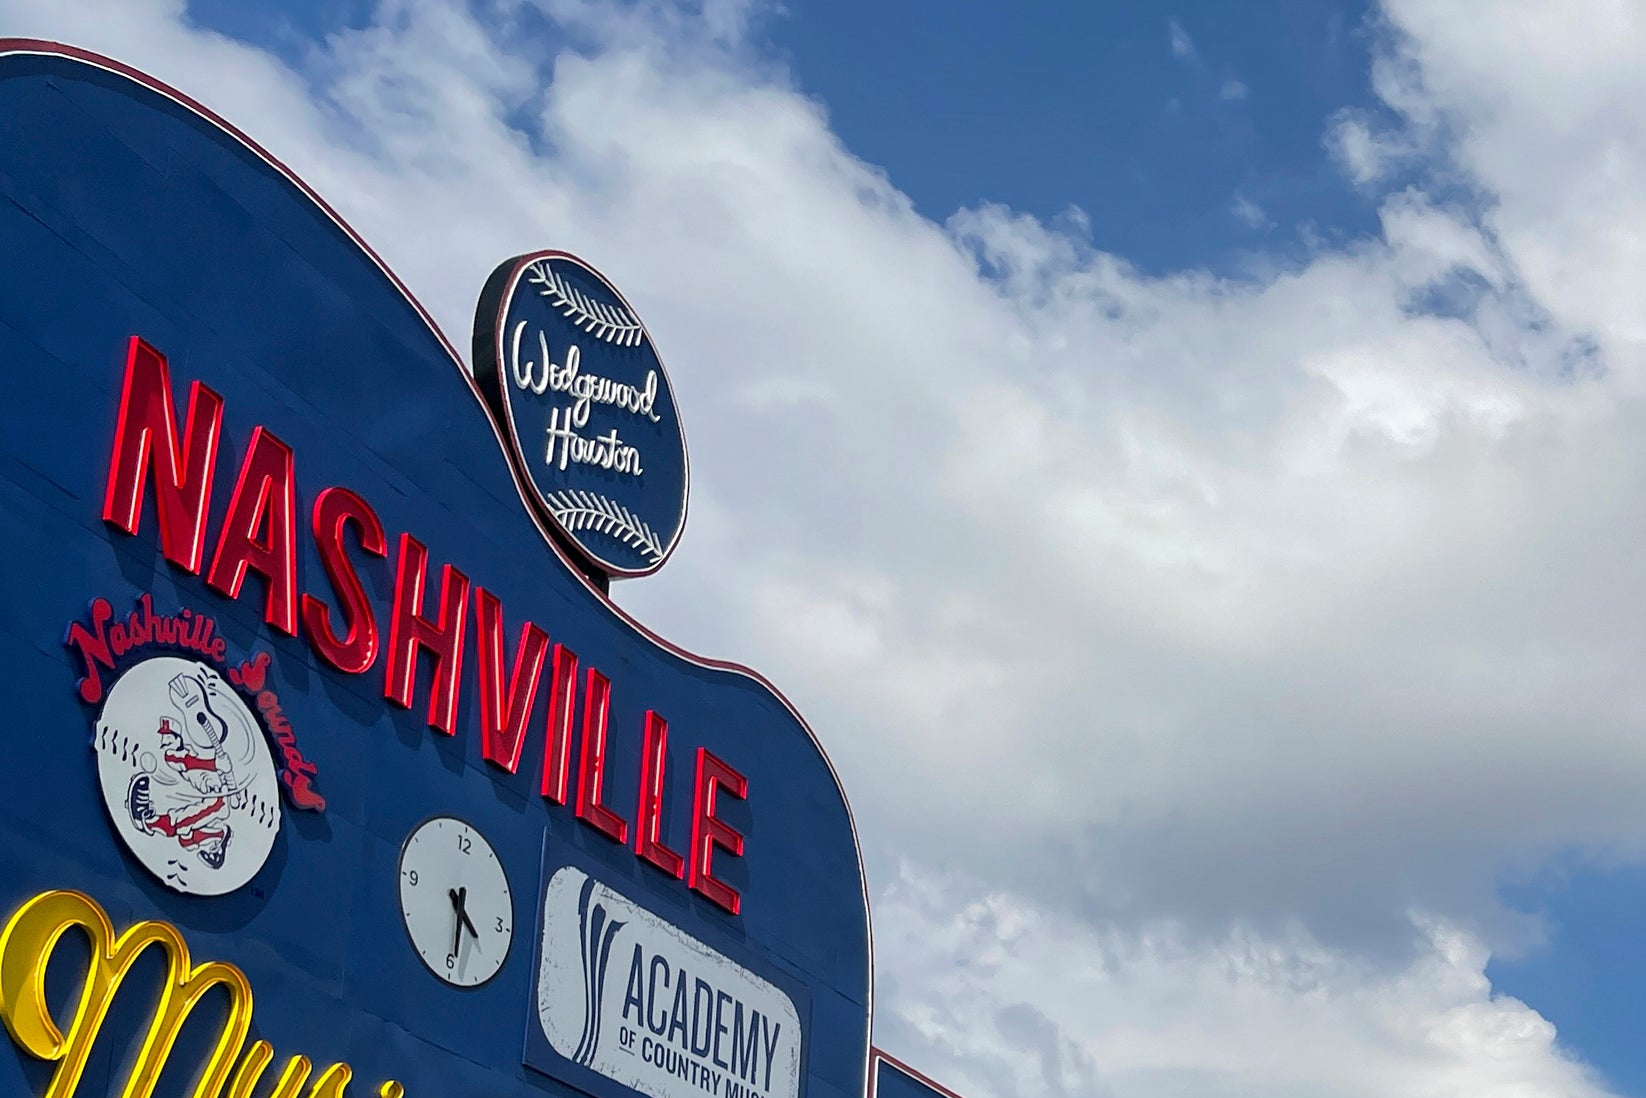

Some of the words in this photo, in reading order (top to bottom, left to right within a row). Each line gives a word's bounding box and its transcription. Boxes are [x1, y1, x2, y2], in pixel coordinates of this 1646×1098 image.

[511, 320, 661, 428] Wedgewood
[545, 407, 643, 476] Houston
[67, 592, 228, 704] Nashville
[103, 335, 748, 916] NASHVILLE
[229, 652, 326, 812] Sounds
[409, 870, 419, 886] 9
[458, 835, 472, 855] 12
[495, 917, 503, 933] 3
[446, 953, 455, 969] 6
[622, 943, 781, 1092] ACADEMY
[619, 1026, 637, 1049] OF
[642, 1037, 721, 1096] COUNTRY
